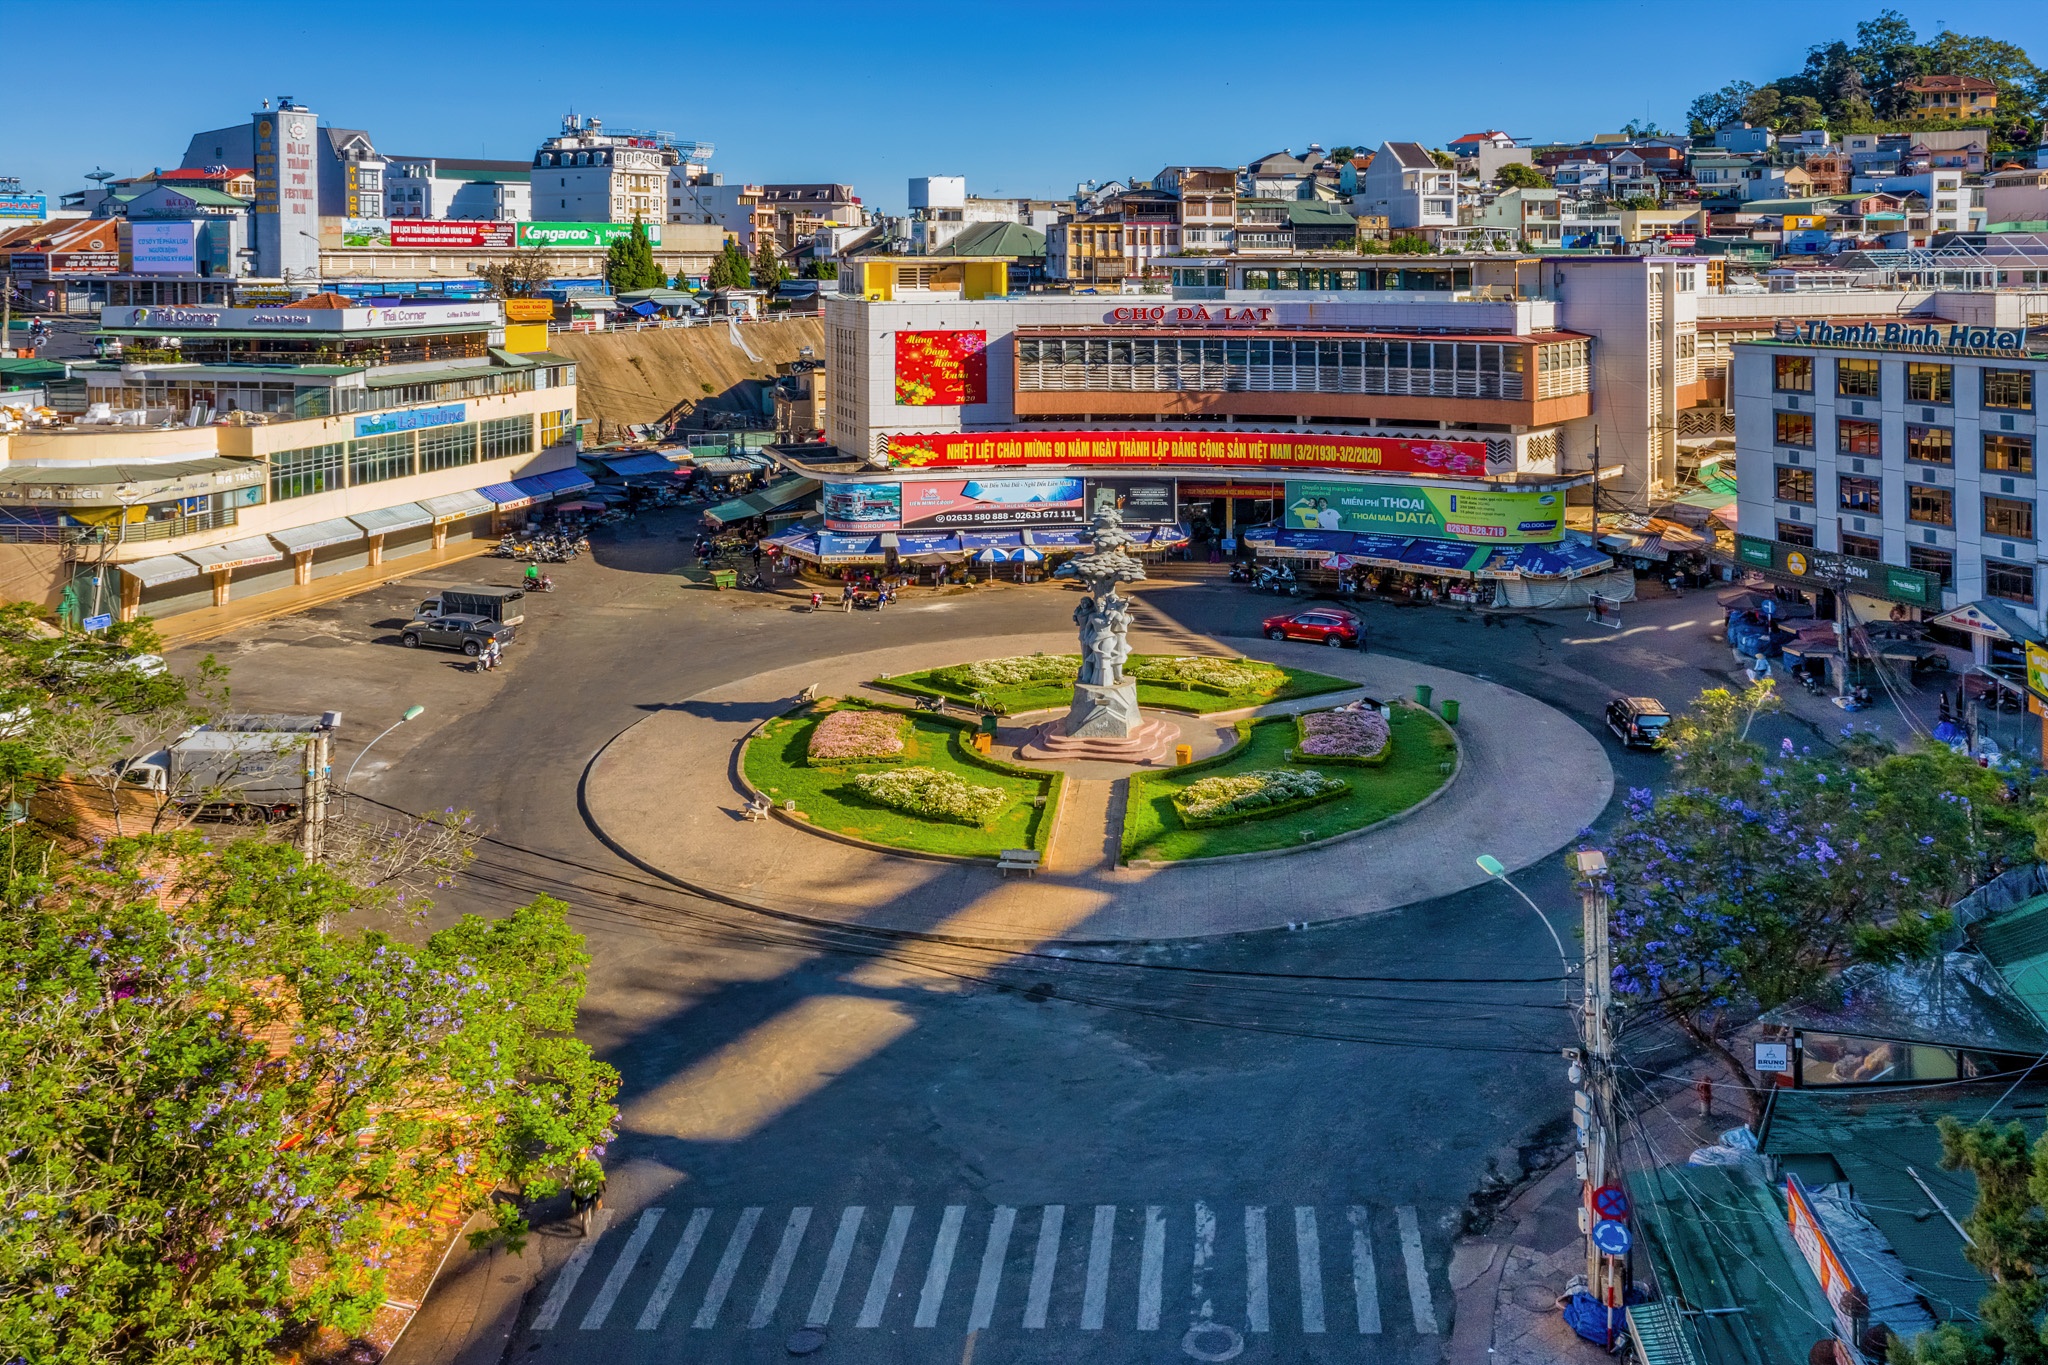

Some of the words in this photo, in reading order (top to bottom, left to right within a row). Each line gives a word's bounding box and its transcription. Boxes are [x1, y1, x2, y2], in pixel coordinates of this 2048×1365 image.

[349, 166, 358, 190] KIM
[521, 225, 588, 242] Kangaroo
[152, 307, 174, 322] Thai
[177, 310, 220, 325] Corner
[380, 308, 398, 322] Thai
[399, 310, 427, 322] Corner
[446, 311, 459, 319] Coffee
[1113, 305, 1165, 324] CHỢ
[1176, 304, 1211, 321] ĐÀ
[1224, 307, 1273, 324] LẠT
[1805, 321, 1879, 343] Thanh
[1949, 325, 2026, 349] Hotel
[398, 415, 417, 429] La
[421, 410, 464, 425] Tulipe
[947, 440, 974, 462] NHIỆT
[976, 439, 995, 462] LIỆT
[997, 439, 1022, 459] CHÀO
[1024, 438, 1052, 459] MỪNG
[1054, 443, 1066, 458] 90
[1068, 438, 1090, 458] NĂM
[1092, 438, 1117, 458] NGÀY
[1119, 438, 1150, 458] THÀNH
[1152, 438, 1169, 460] LẬP
[1172, 436, 1197, 458] ĐẢNG
[1200, 438, 1225, 461] CỘNG
[1227, 437, 1247, 459] SẢN
[1248, 440, 1267, 462] VIỆT
[1270, 444, 1292, 460] NAM
[1294, 444, 1383, 466] (3/2/1930-3/2/2020)
[504, 503, 520, 511] KIM
[1365, 497, 1379, 507] PHÍ
[1380, 496, 1425, 512] THOẠI
[946, 514, 973, 522] 02633
[974, 513, 991, 521] 580
[1015, 512, 1042, 520] 02633
[1043, 511, 1059, 519] 671
[1060, 510, 1077, 518] 111
[1395, 511, 1437, 525] DATA
[210, 563, 224, 571] KIM
[225, 559, 243, 569] OANH
